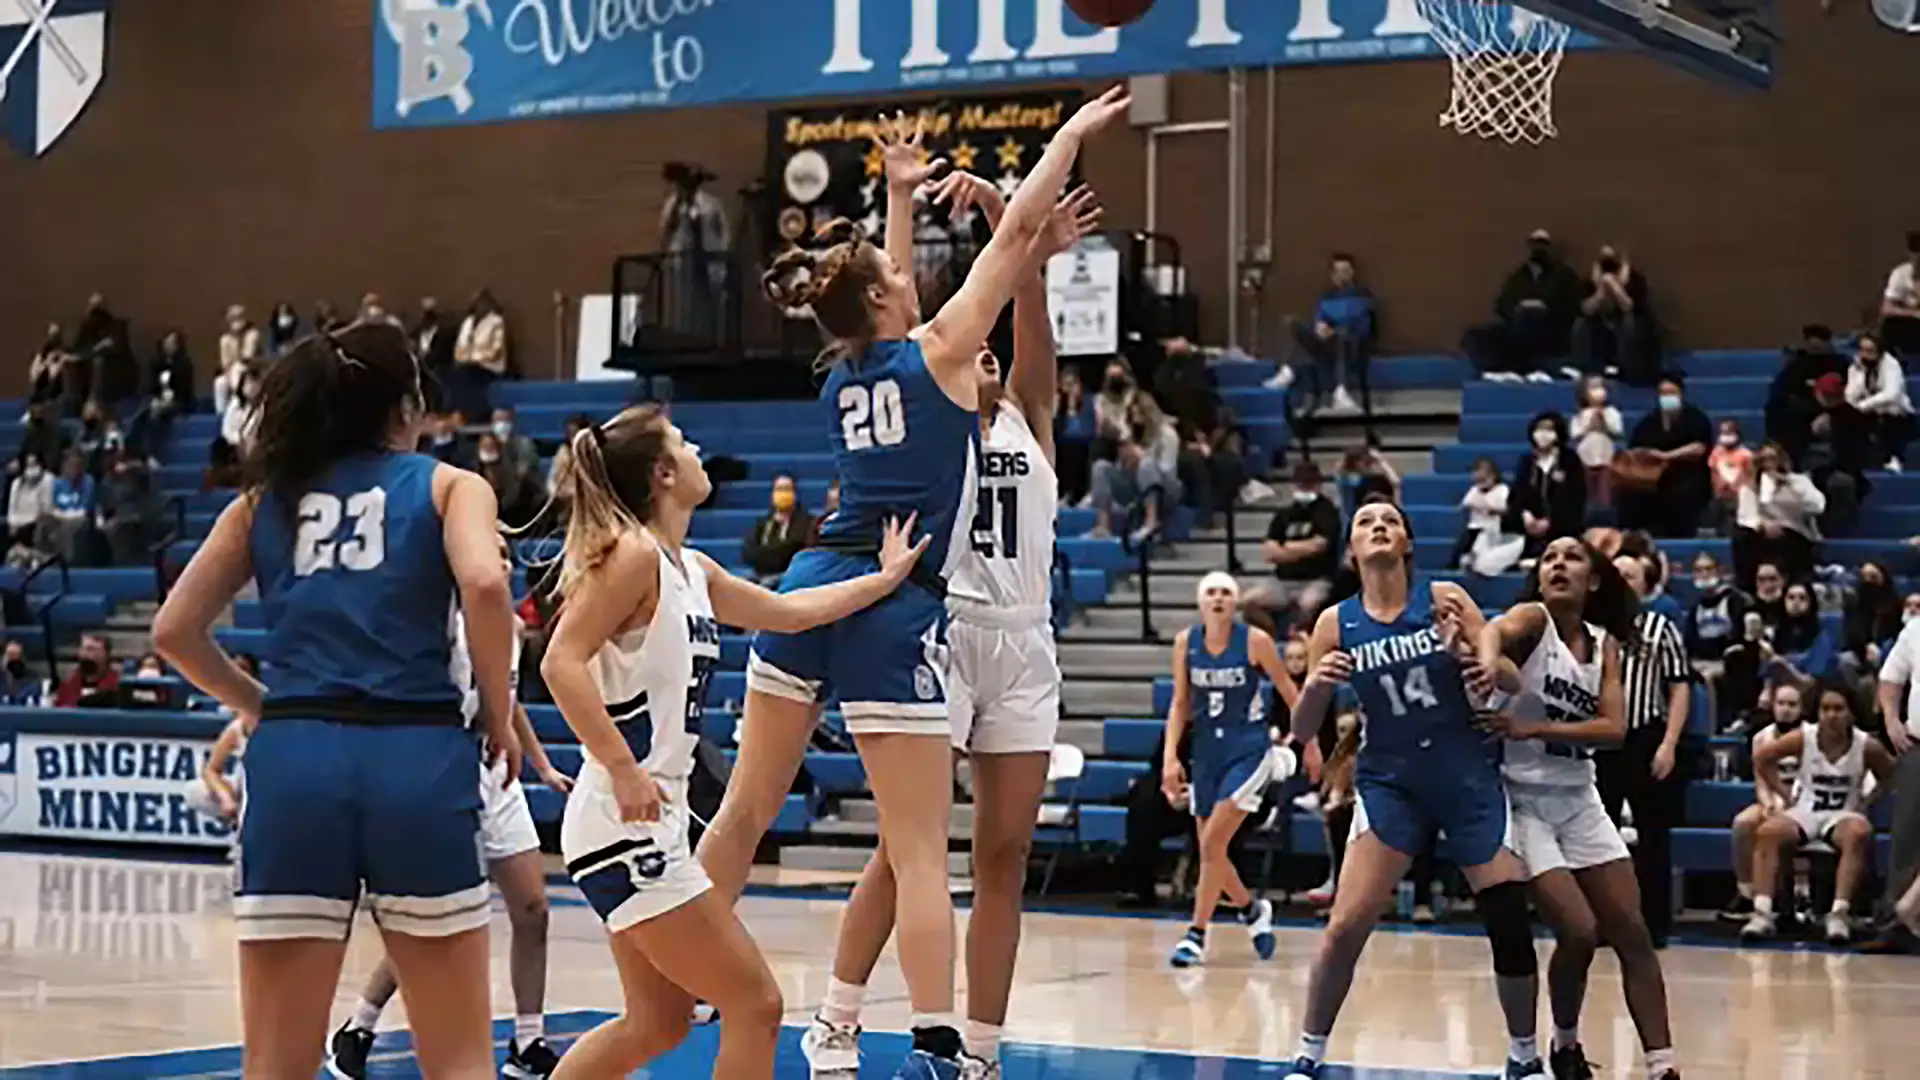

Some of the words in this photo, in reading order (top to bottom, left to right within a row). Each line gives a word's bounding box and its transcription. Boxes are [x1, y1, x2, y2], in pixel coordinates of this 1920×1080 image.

[504, 0, 713, 65] Welc
[653, 31, 703, 89] to
[786, 107, 950, 146] Sportsmip
[957, 101, 1064, 130] Matters!
[839, 379, 906, 451] 20
[983, 451, 1030, 477] ERS
[294, 486, 387, 577] 23
[1350, 623, 1445, 672] VIKINGS
[1208, 691, 1225, 718] 5
[1379, 665, 1438, 716] 14
